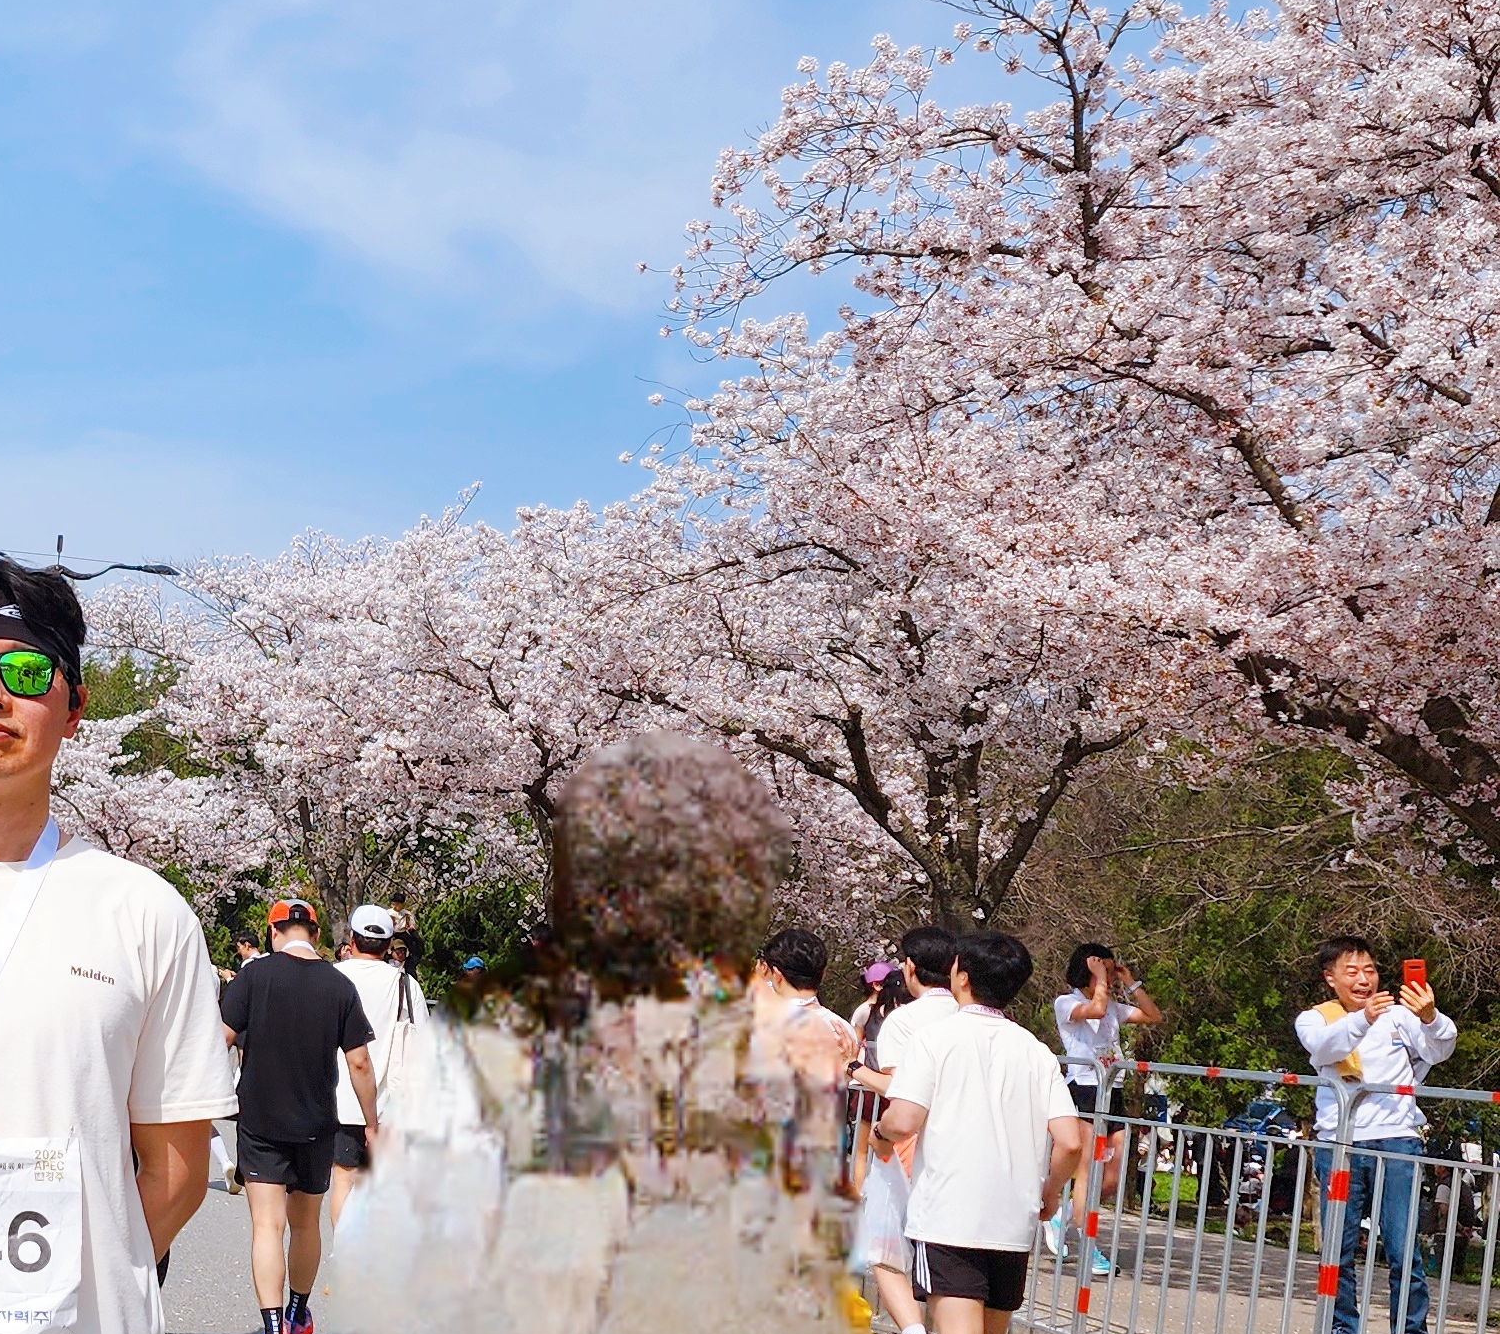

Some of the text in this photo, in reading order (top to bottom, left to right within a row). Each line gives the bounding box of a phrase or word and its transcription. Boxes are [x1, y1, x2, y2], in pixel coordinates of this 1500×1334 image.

[71, 965, 115, 985] Malden
[34, 1149, 64, 1160] 2025
[34, 1160, 65, 1171] APEC
